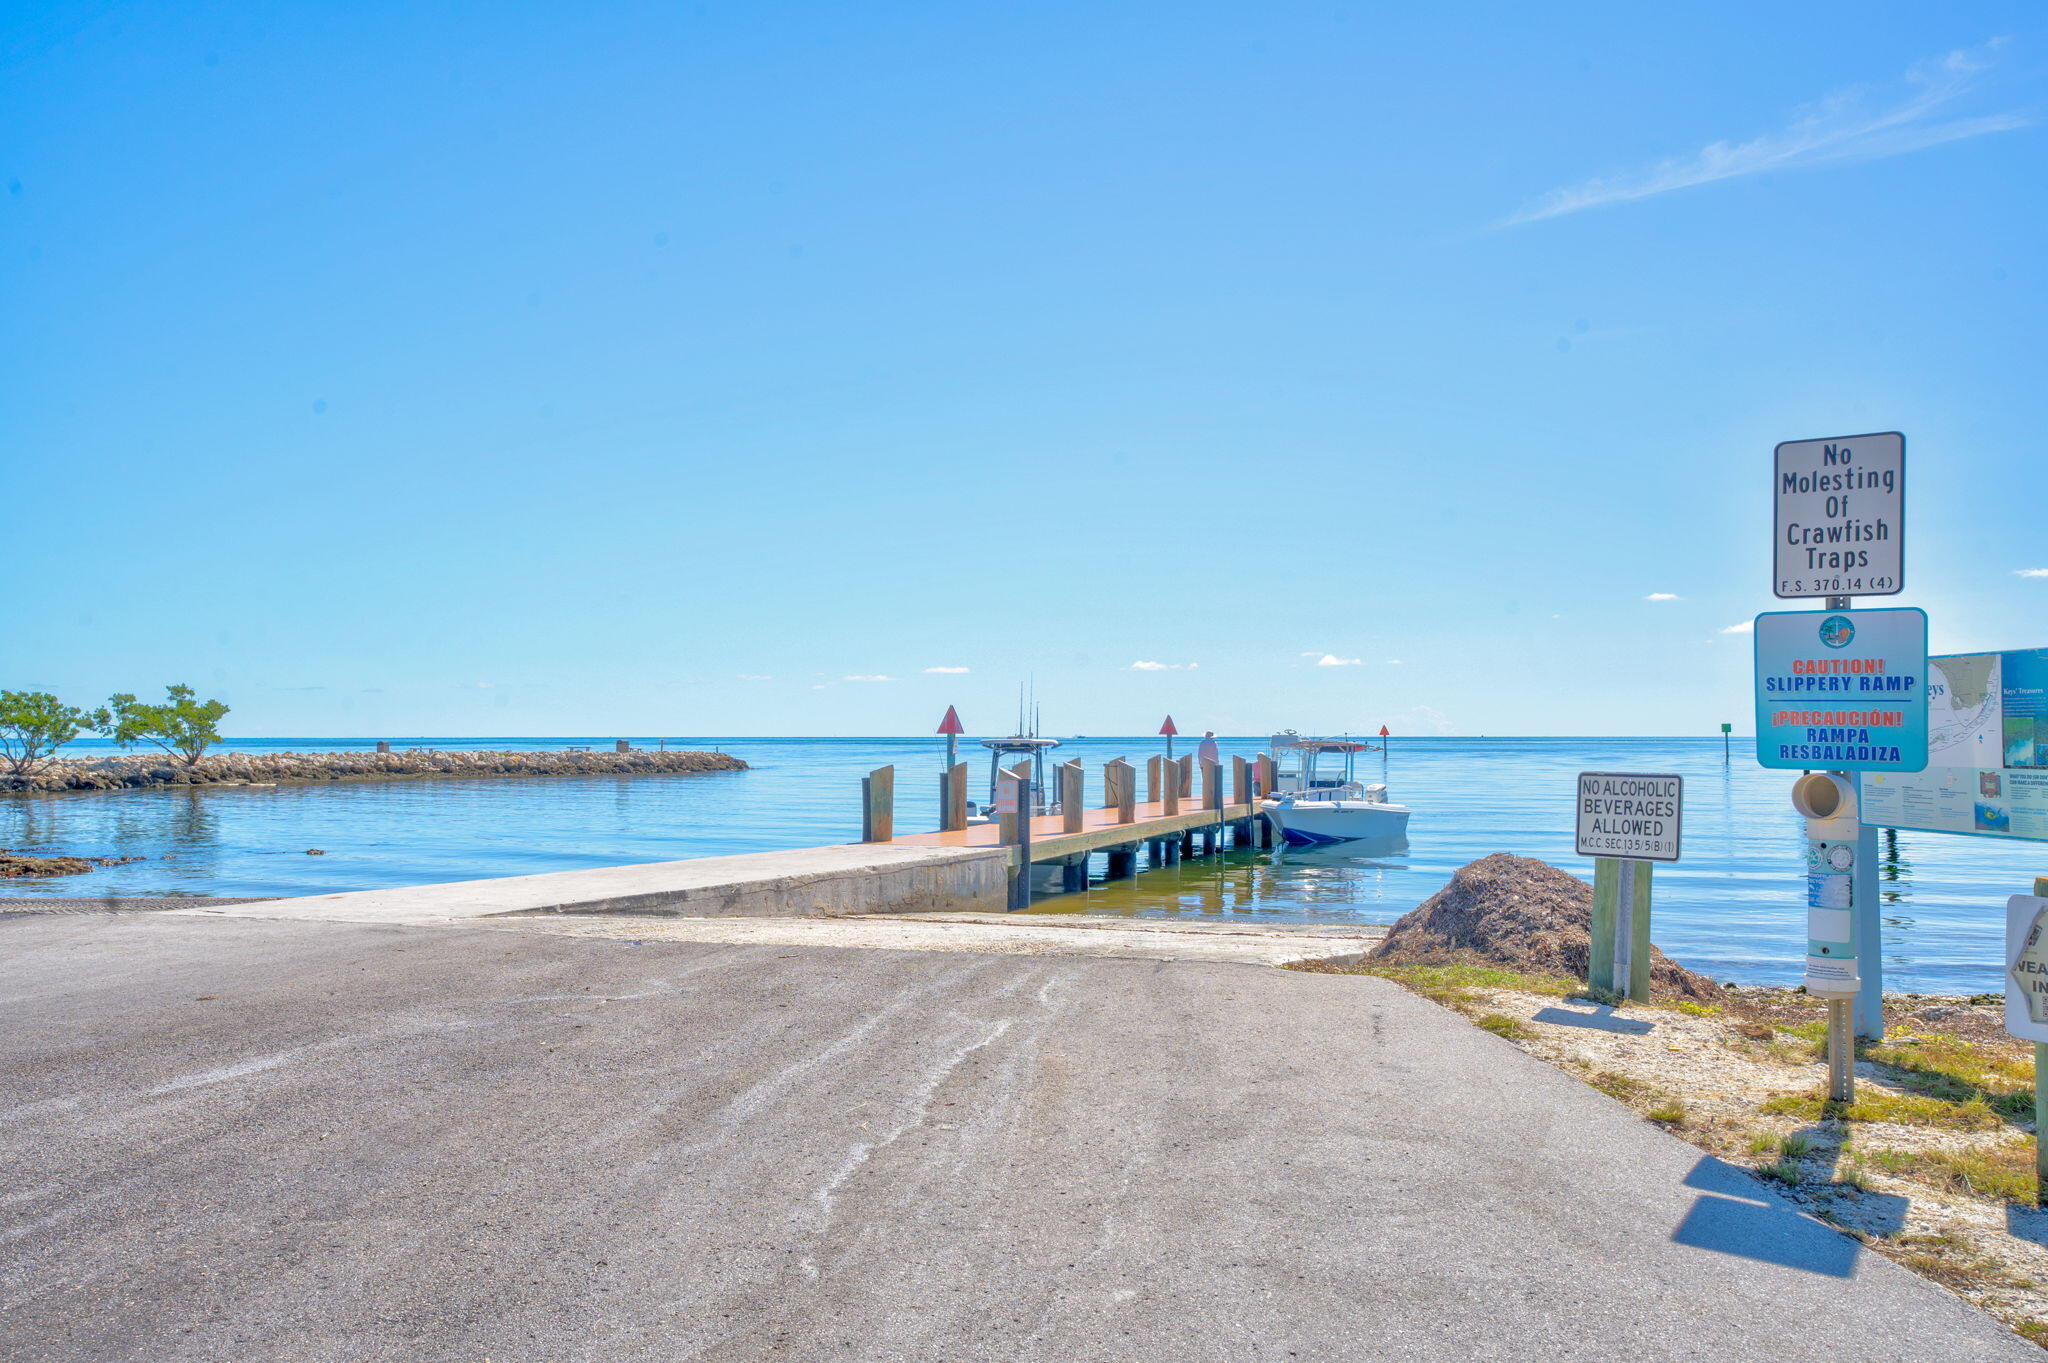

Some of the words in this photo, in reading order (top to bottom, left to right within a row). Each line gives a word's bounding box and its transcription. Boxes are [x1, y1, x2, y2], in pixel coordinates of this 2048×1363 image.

[1823, 444, 1851, 466] No
[1782, 466, 1894, 494] Molesting
[1825, 495, 1848, 518] Of
[1787, 518, 1888, 545] Crawfish
[1805, 547, 1868, 572] Traps
[1782, 580, 1807, 592] F.S.
[1814, 578, 1861, 591] 370.14
[1870, 576, 1893, 590] (4)
[1792, 659, 1885, 674] CAUTION!
[1766, 677, 1851, 691] SLIPPERY
[1859, 676, 1915, 691] RAMP
[1772, 709, 1903, 726] ¡PRECAUCIÓN!
[1806, 728, 1869, 743] RAMPA
[1779, 744, 1901, 761] RESBALADIZA
[1583, 780, 1600, 796] NO
[1603, 780, 1676, 797] ALCOHOLIC
[1584, 799, 1674, 817] BEVERAGES
[1592, 818, 1663, 837] ALLOWED
